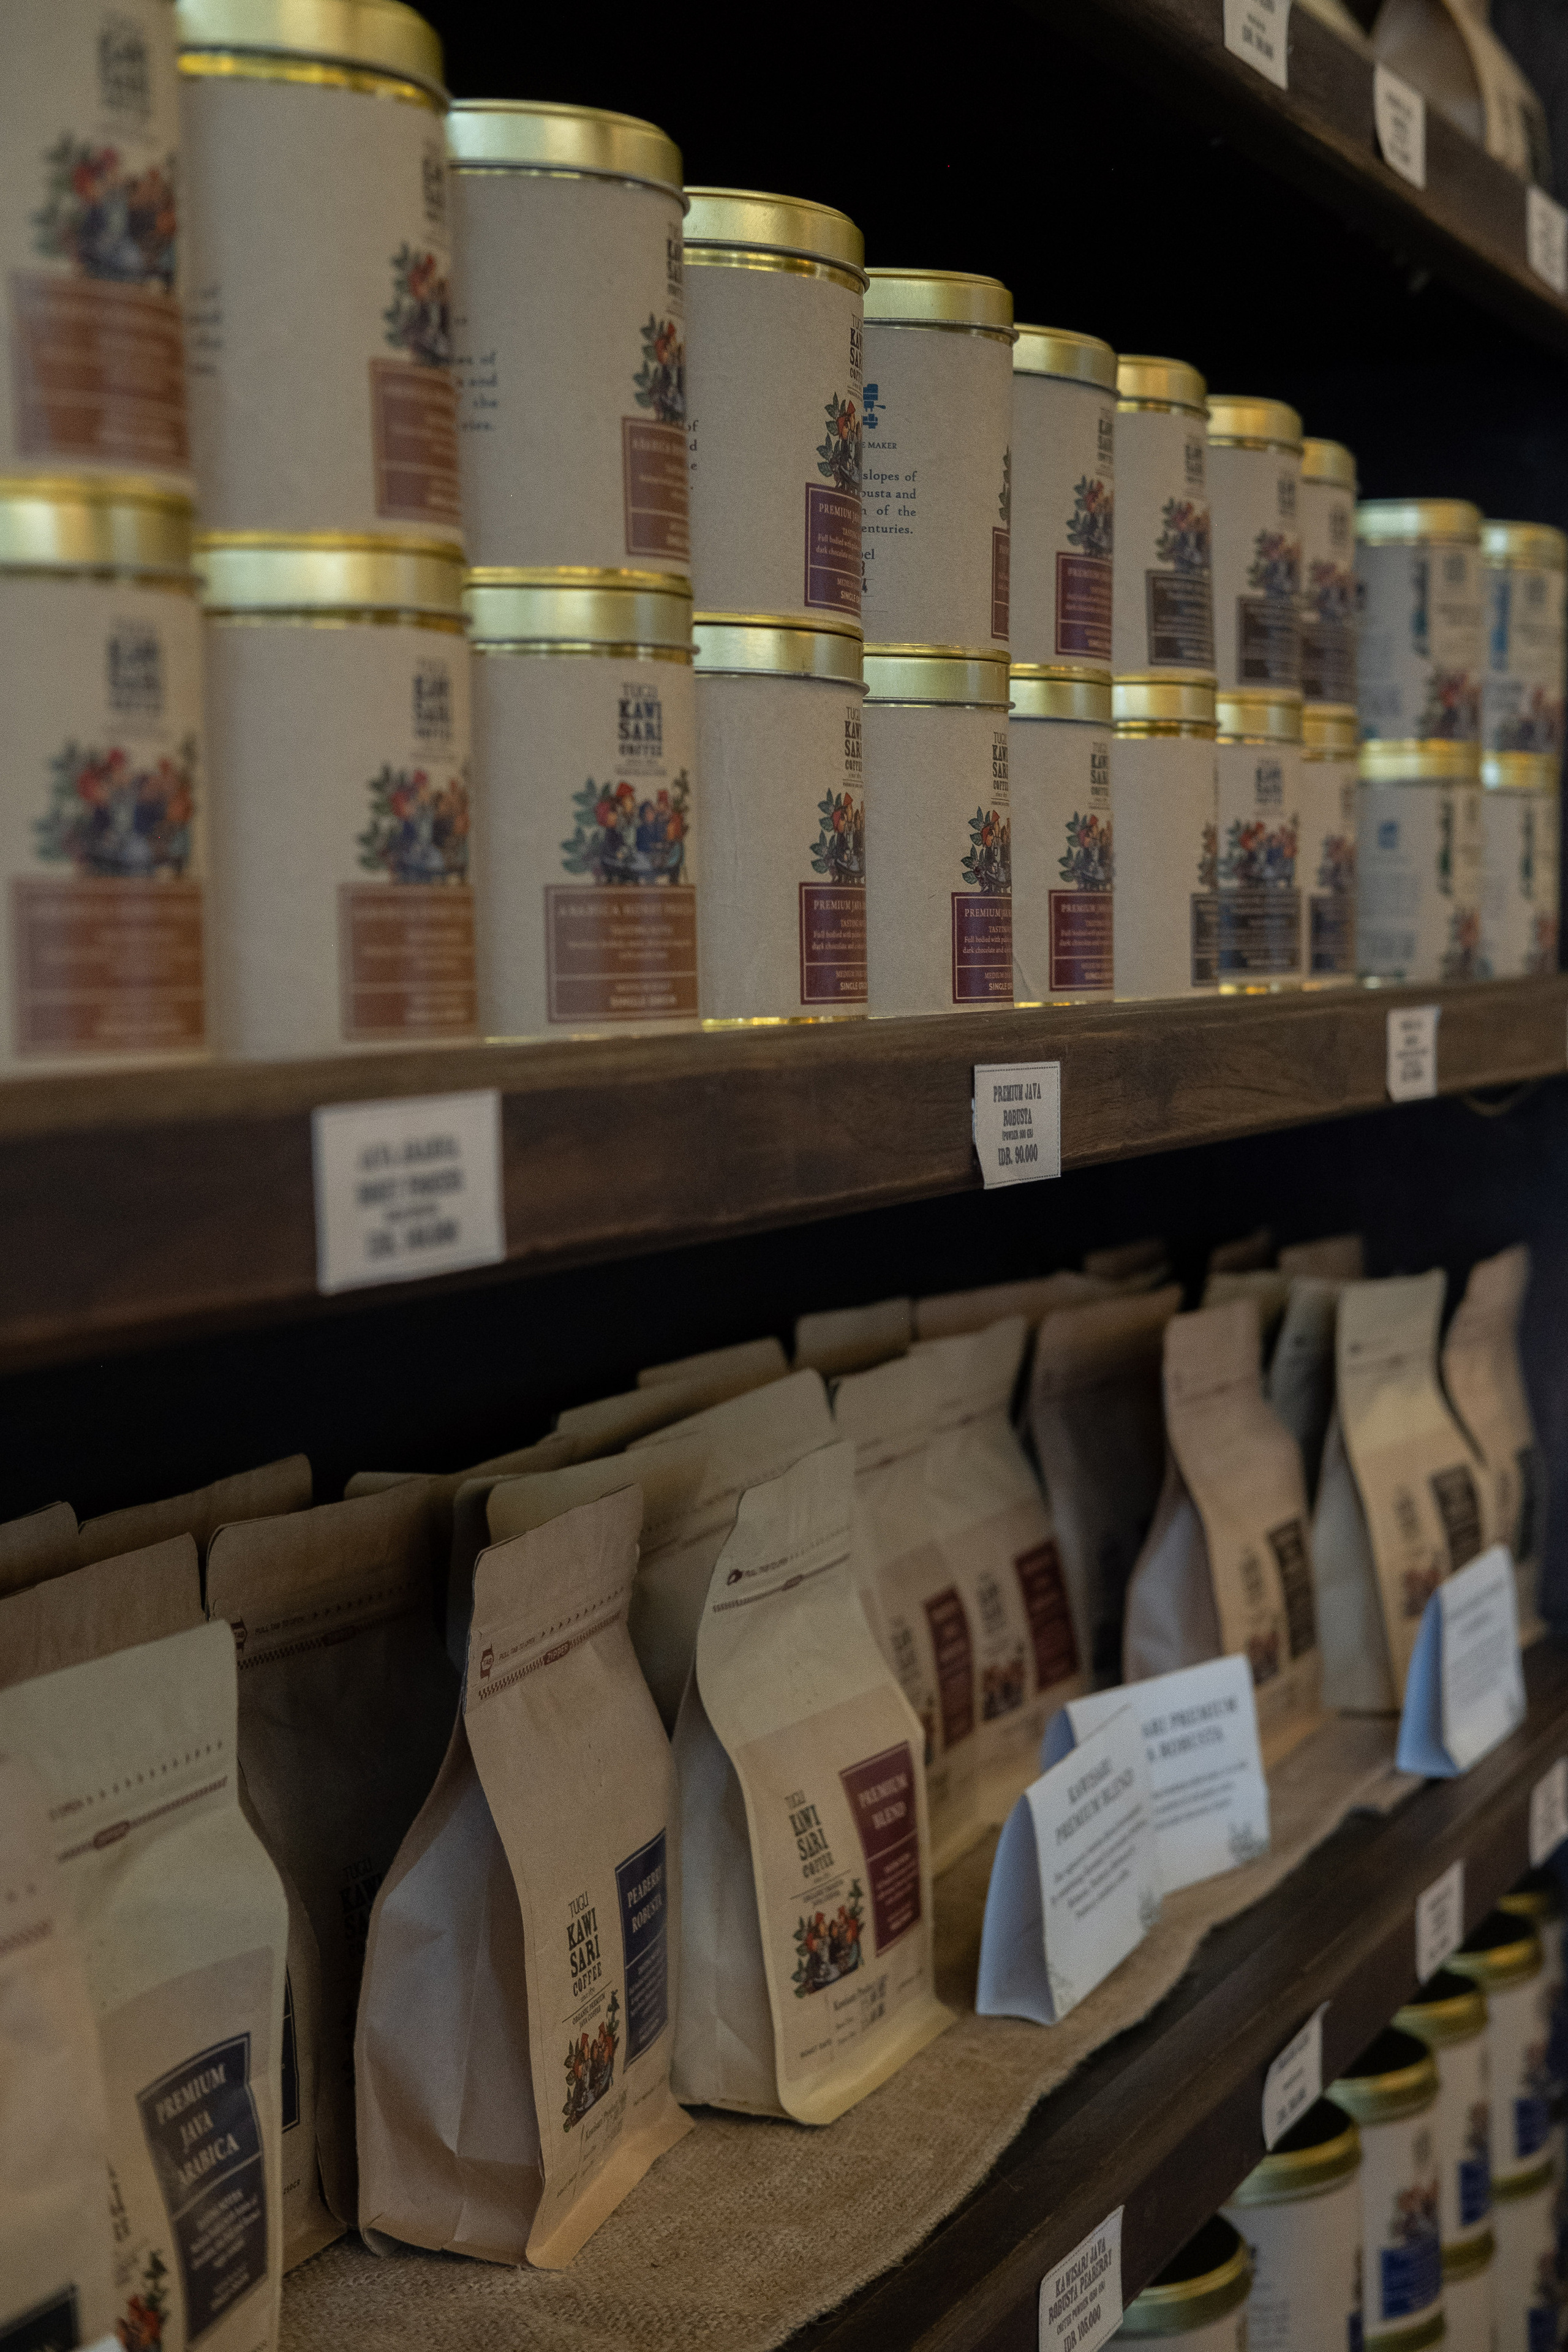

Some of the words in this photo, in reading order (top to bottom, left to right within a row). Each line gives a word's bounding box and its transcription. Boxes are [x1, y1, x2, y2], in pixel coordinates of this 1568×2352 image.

[868, 441, 897, 450] MAKER
[862, 469, 900, 484] slopes
[904, 470, 918, 482] of
[895, 488, 916, 499] and
[818, 502, 852, 519] PREMIUM
[876, 505, 890, 516] of
[898, 505, 917, 516] the
[861, 524, 913, 534] enturies.
[619, 699, 662, 719] KAWI
[619, 722, 662, 741] SARI
[813, 900, 851, 910] PREMIUM
[964, 908, 1001, 918] PREMIUM
[993, 1084, 1023, 1103] PREMIUM
[1024, 1082, 1042, 1101] JAVA
[1003, 1107, 1033, 1127] ROBUSTA
[998, 1147, 1012, 1166] IDR.
[1014, 1144, 1038, 1165] 90.000
[546, 1643, 570, 1664] ZIPPER
[788, 1803, 821, 1837] KAWI
[797, 1827, 829, 1861] SARI
[568, 1891, 589, 1918] TUGU
[567, 1907, 598, 1951] KAWI
[570, 1934, 600, 1978] SARI
[573, 1961, 602, 1997] COFFEE
[155, 2062, 226, 2125] PREMIUM
[179, 2109, 214, 2154] JAVA
[178, 2132, 241, 2187] ARABICA
[1055, 2252, 1088, 2298] KAWISARI
[1090, 2237, 1106, 2264] JAVA
[1048, 2283, 1078, 2326] ROBUSTA
[1080, 2248, 1112, 2295] PEABERRY
[1063, 2330, 1077, 2352] IDR
